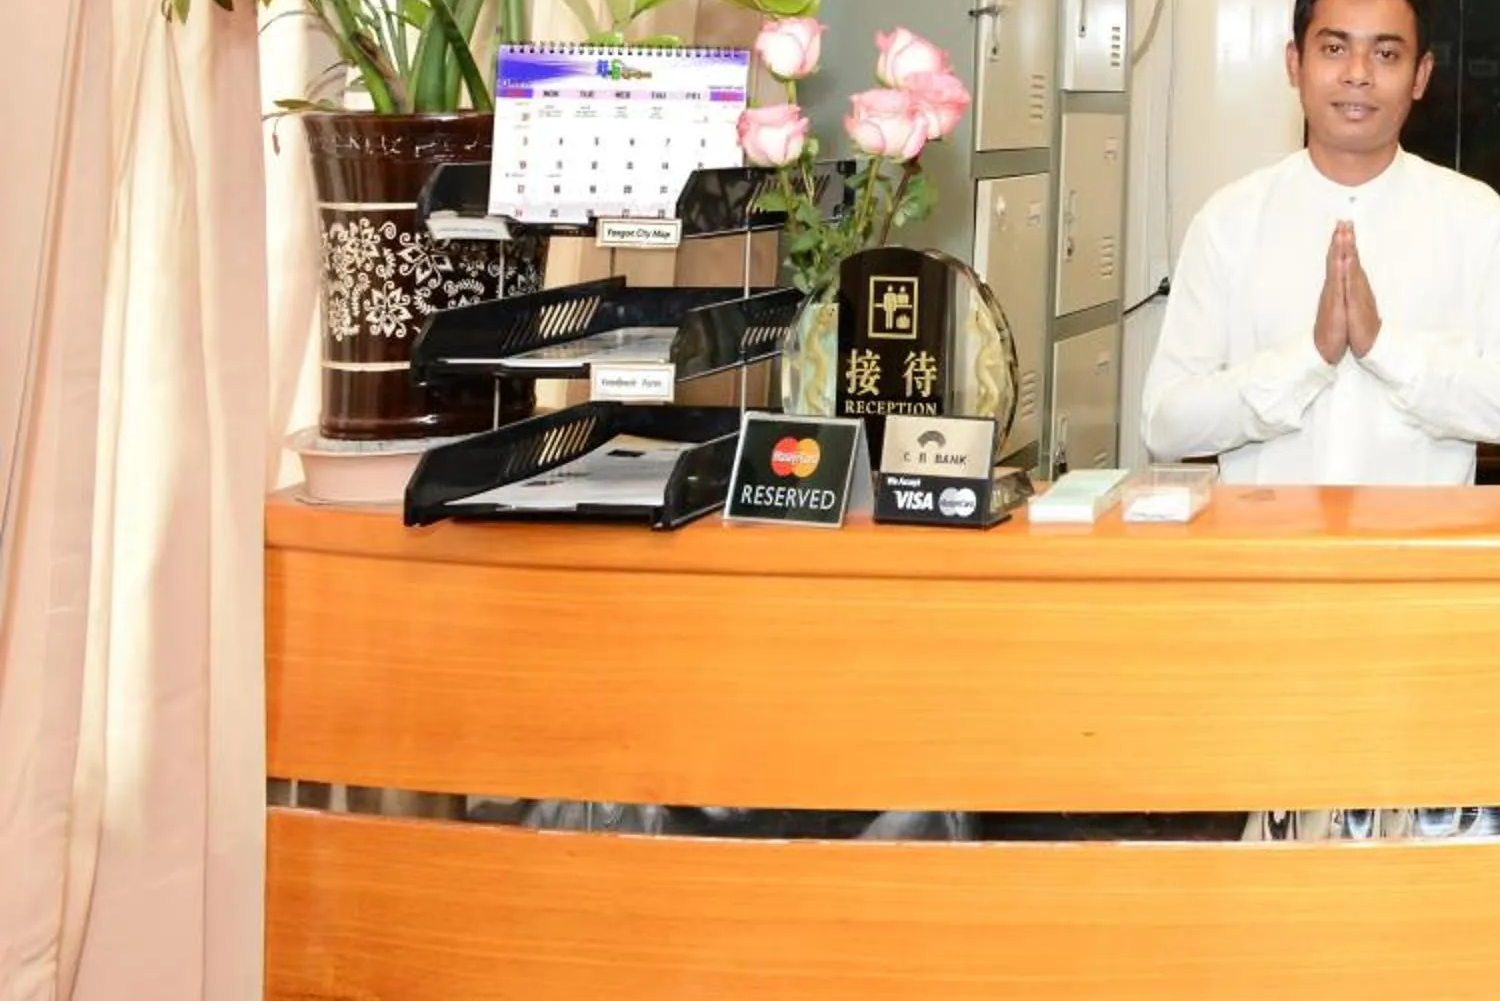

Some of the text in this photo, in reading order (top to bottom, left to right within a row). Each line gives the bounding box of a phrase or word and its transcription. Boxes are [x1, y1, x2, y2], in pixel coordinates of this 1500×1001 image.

[845, 348, 937, 398] 接待
[845, 401, 937, 416] RECEPTION
[934, 453, 967, 465] BANK
[741, 484, 835, 510] RESERVED
[893, 490, 933, 510] VISA
